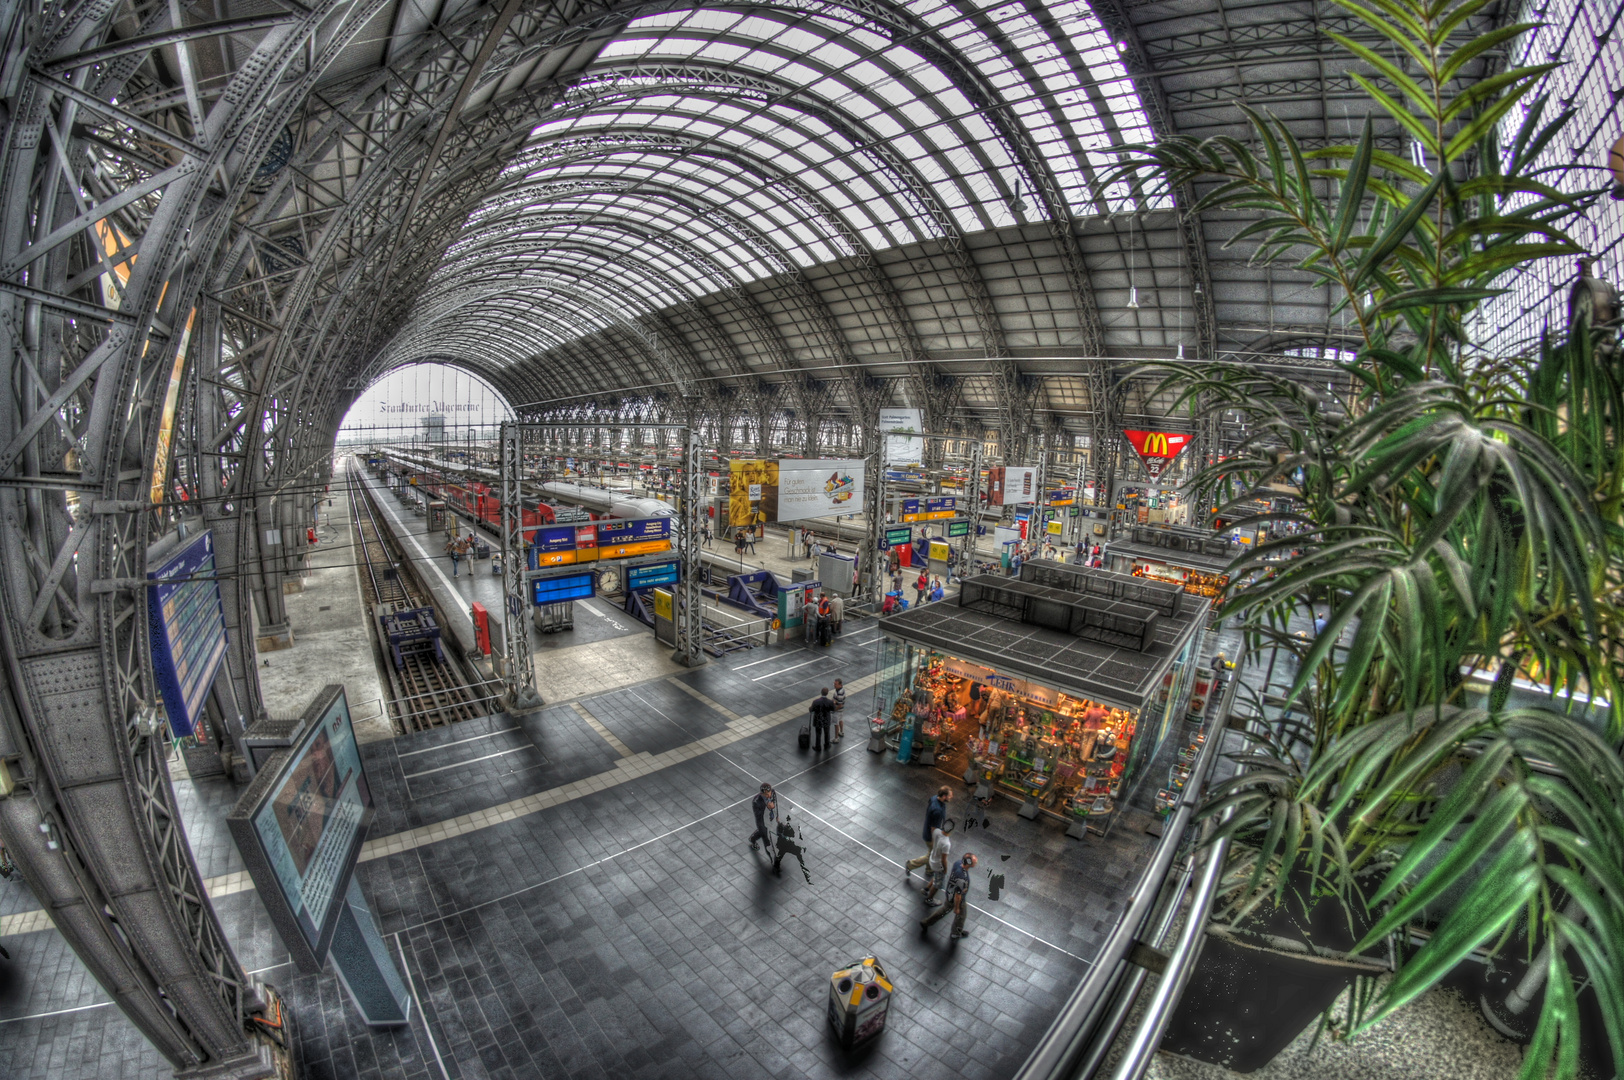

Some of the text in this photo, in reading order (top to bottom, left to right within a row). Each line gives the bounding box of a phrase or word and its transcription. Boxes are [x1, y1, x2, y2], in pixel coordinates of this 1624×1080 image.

[380, 400, 480, 415] Frankfurter Allgemeine
[1150, 466, 1160, 474] 22
[881, 539, 886, 549] 6
[702, 569, 708, 581] 5
